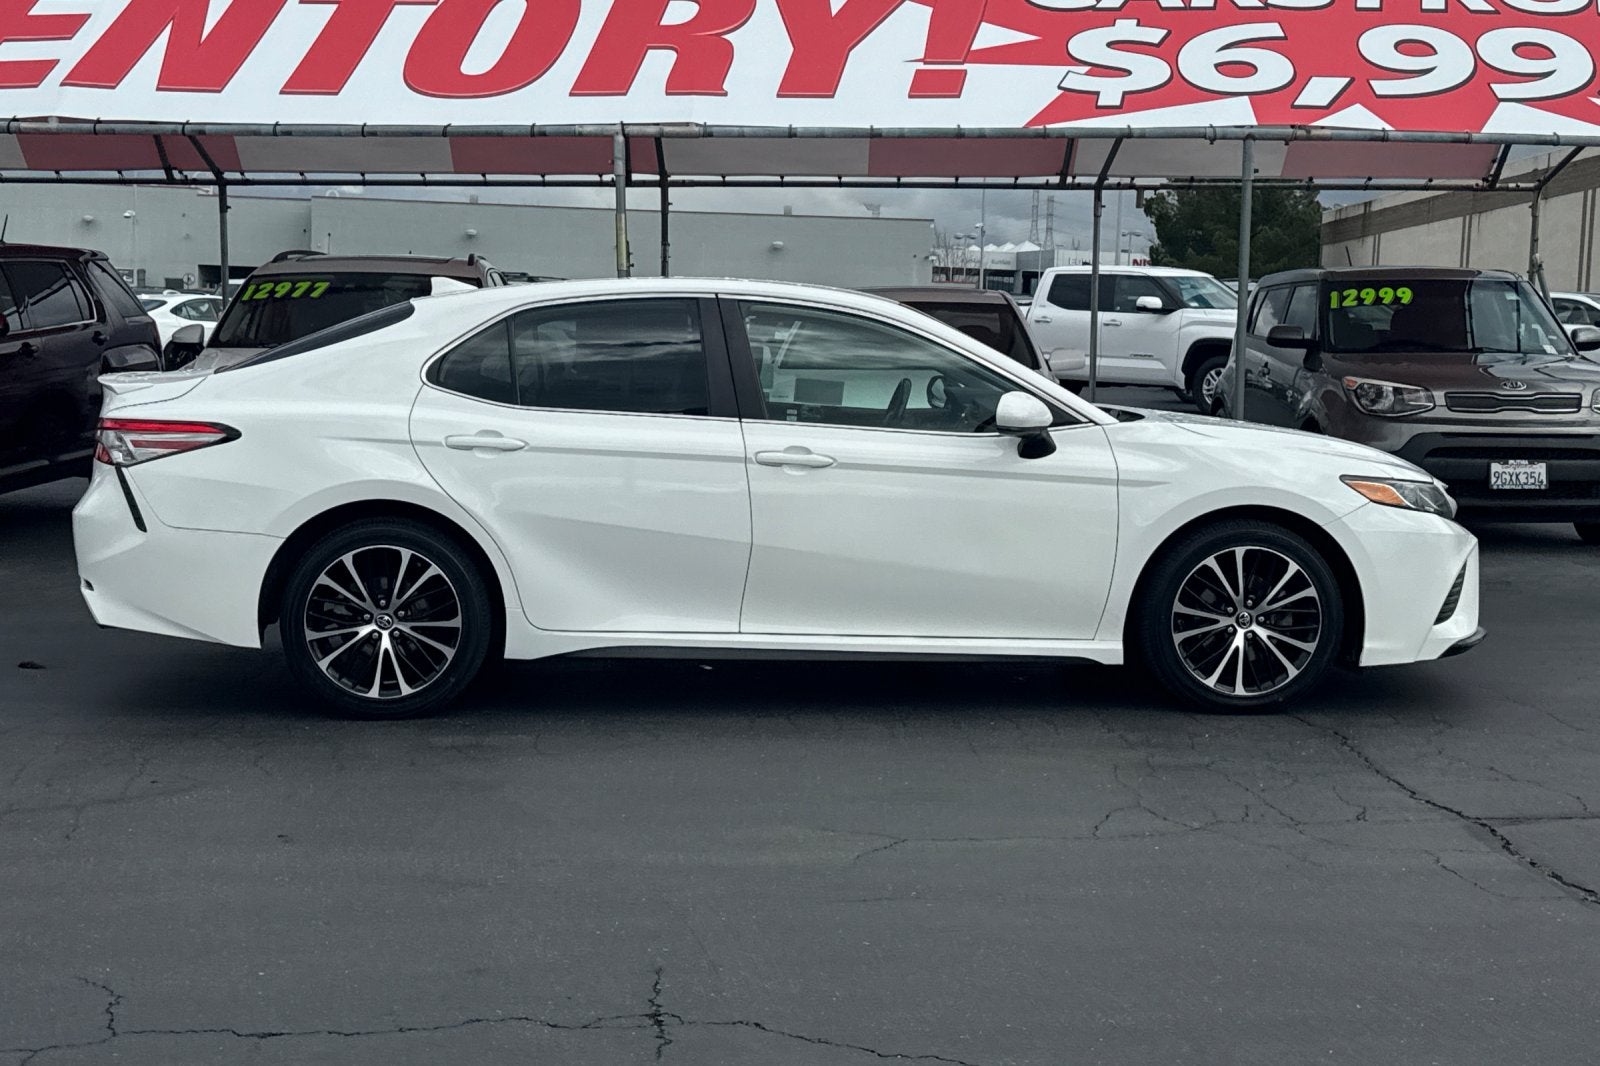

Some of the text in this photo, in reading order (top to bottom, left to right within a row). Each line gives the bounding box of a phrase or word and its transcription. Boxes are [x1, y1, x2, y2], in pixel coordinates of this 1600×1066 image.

[242, 281, 331, 301] 12977
[1330, 287, 1413, 309] 12999
[1493, 470, 1545, 486] 9GXK354
